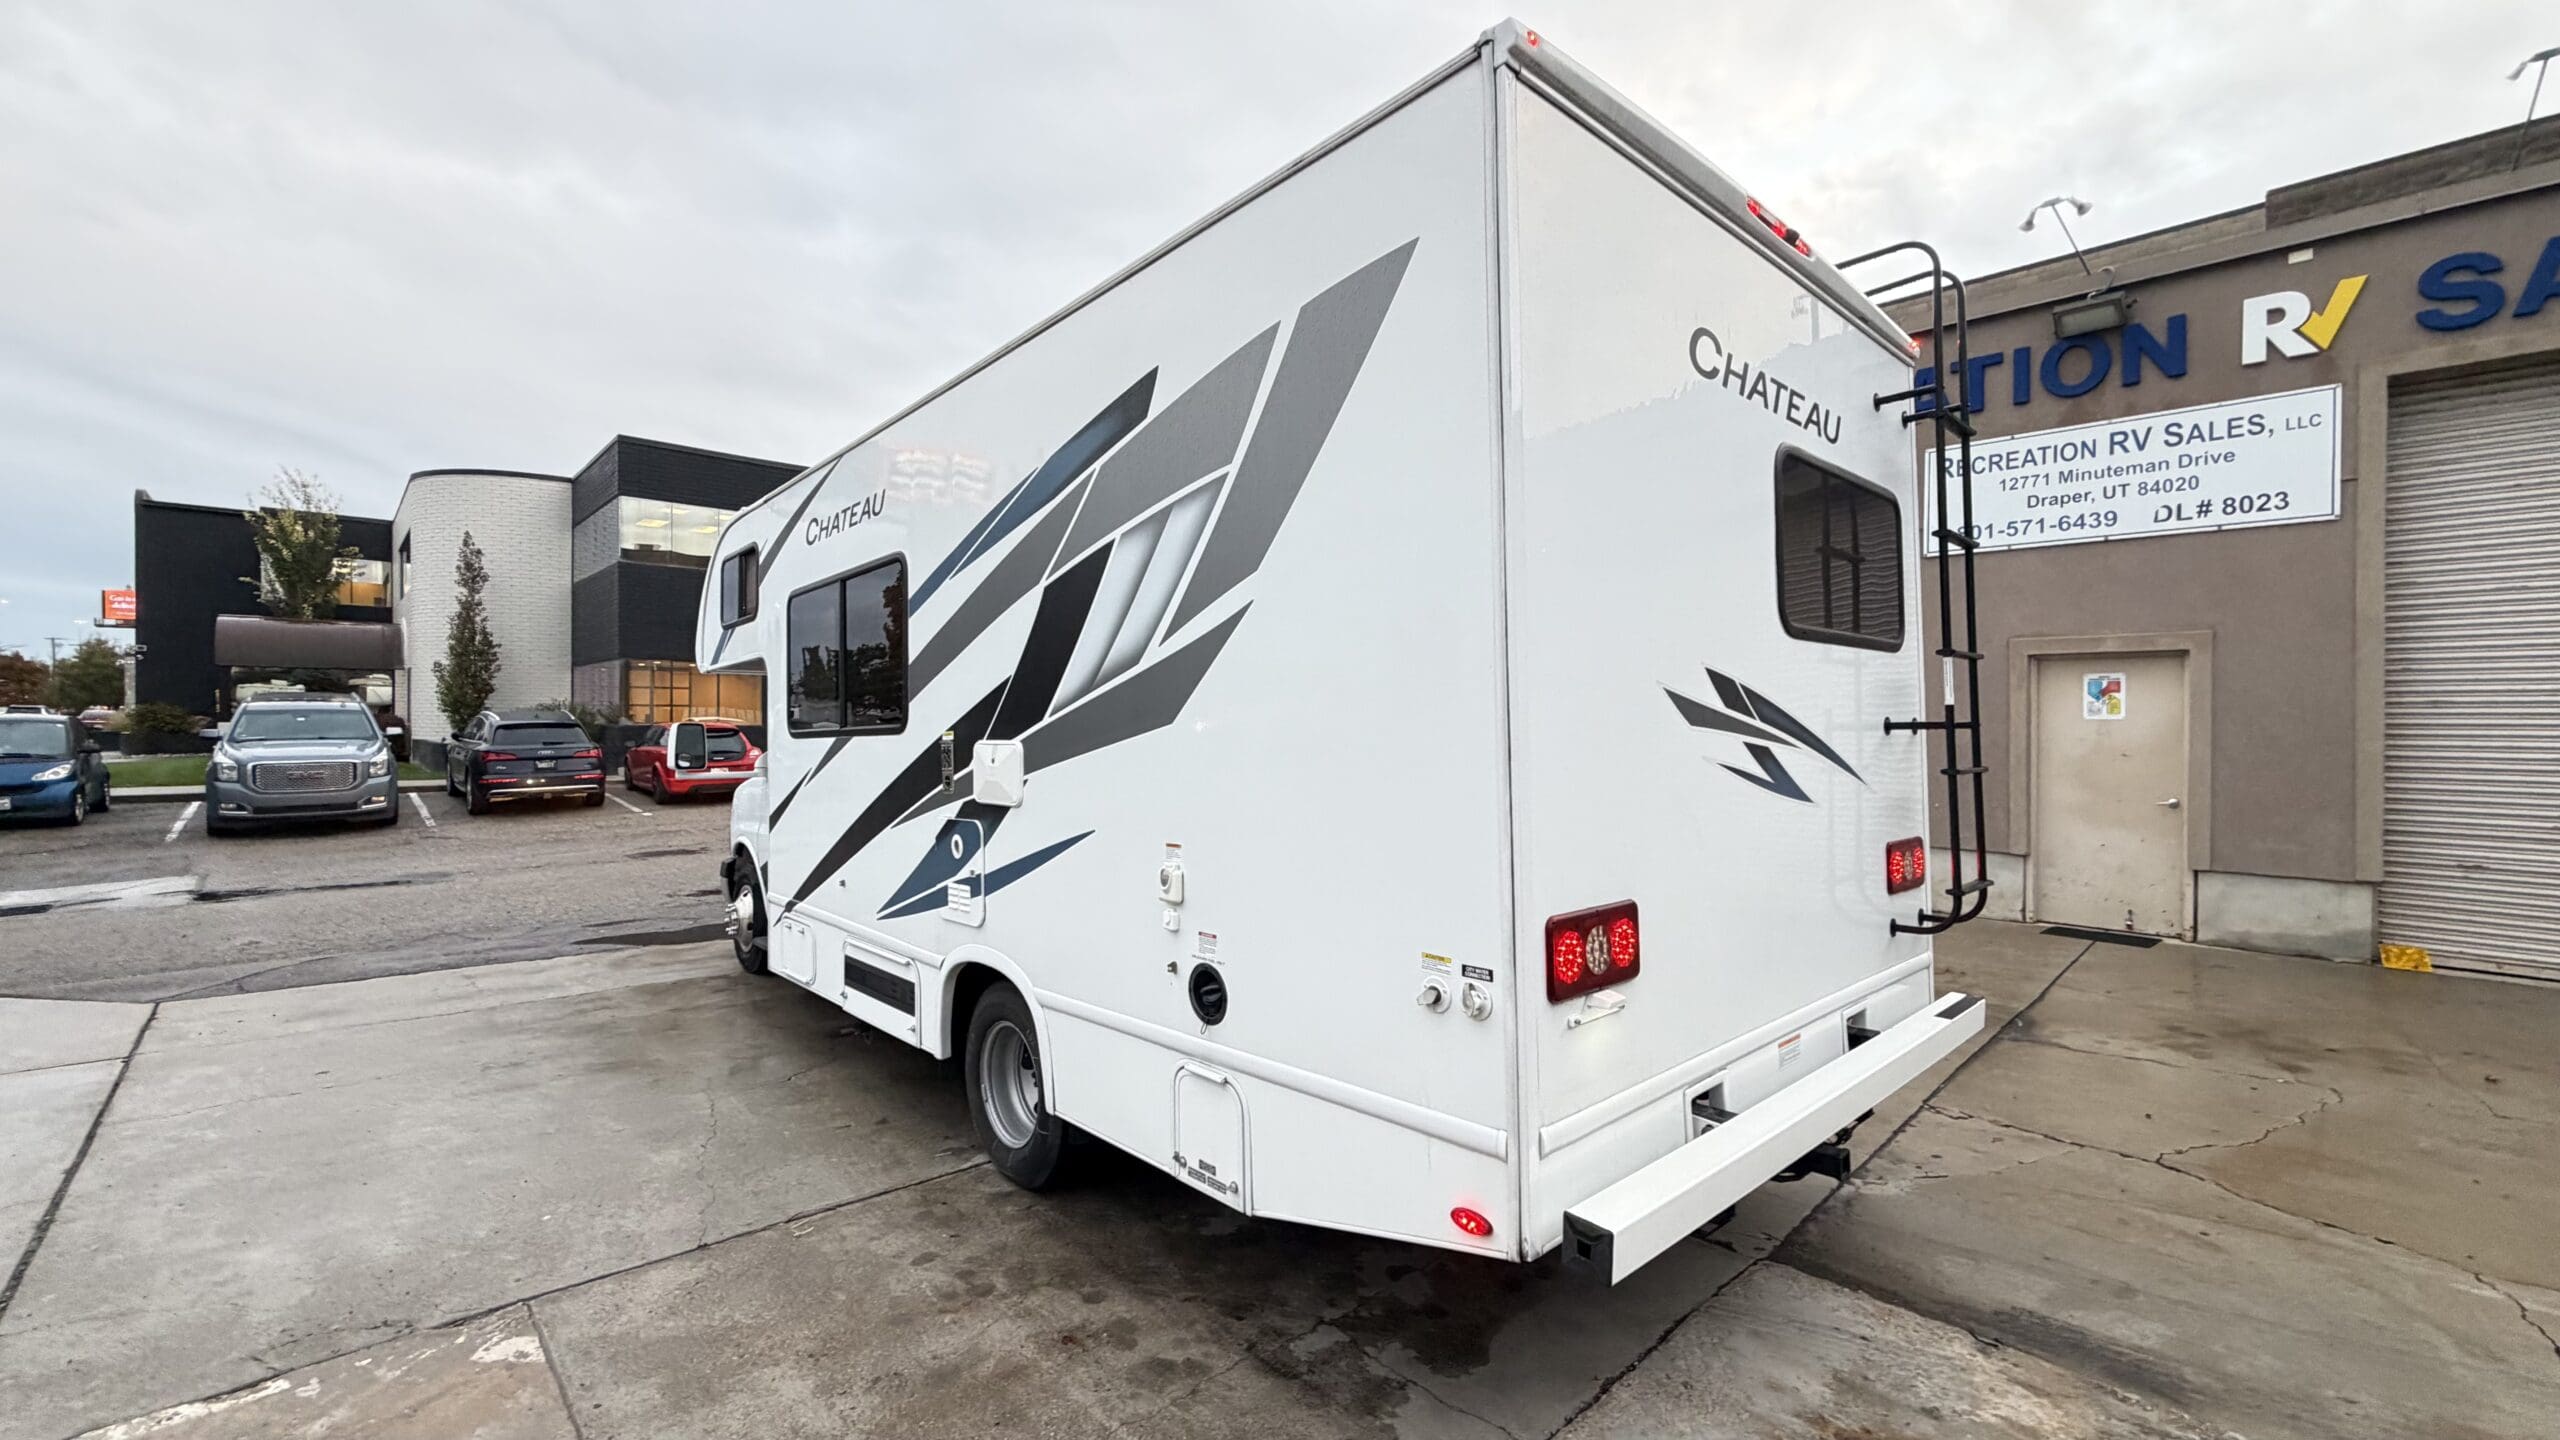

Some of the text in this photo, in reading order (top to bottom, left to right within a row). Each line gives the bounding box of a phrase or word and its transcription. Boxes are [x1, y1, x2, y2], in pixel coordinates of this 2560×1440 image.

[1688, 326, 1842, 445] CHATEAU
[2108, 425, 2153, 455] RV
[2163, 413, 2274, 448] SALES,
[2285, 413, 2323, 432] LLC
[1999, 450, 2236, 492] 12771 Minuteman Drive
[2026, 475, 2200, 510] Draper, UT 84020
[2153, 499, 2213, 523] DL#
[2222, 491, 2290, 516] 8023
[805, 488, 887, 546] CHATEAU
